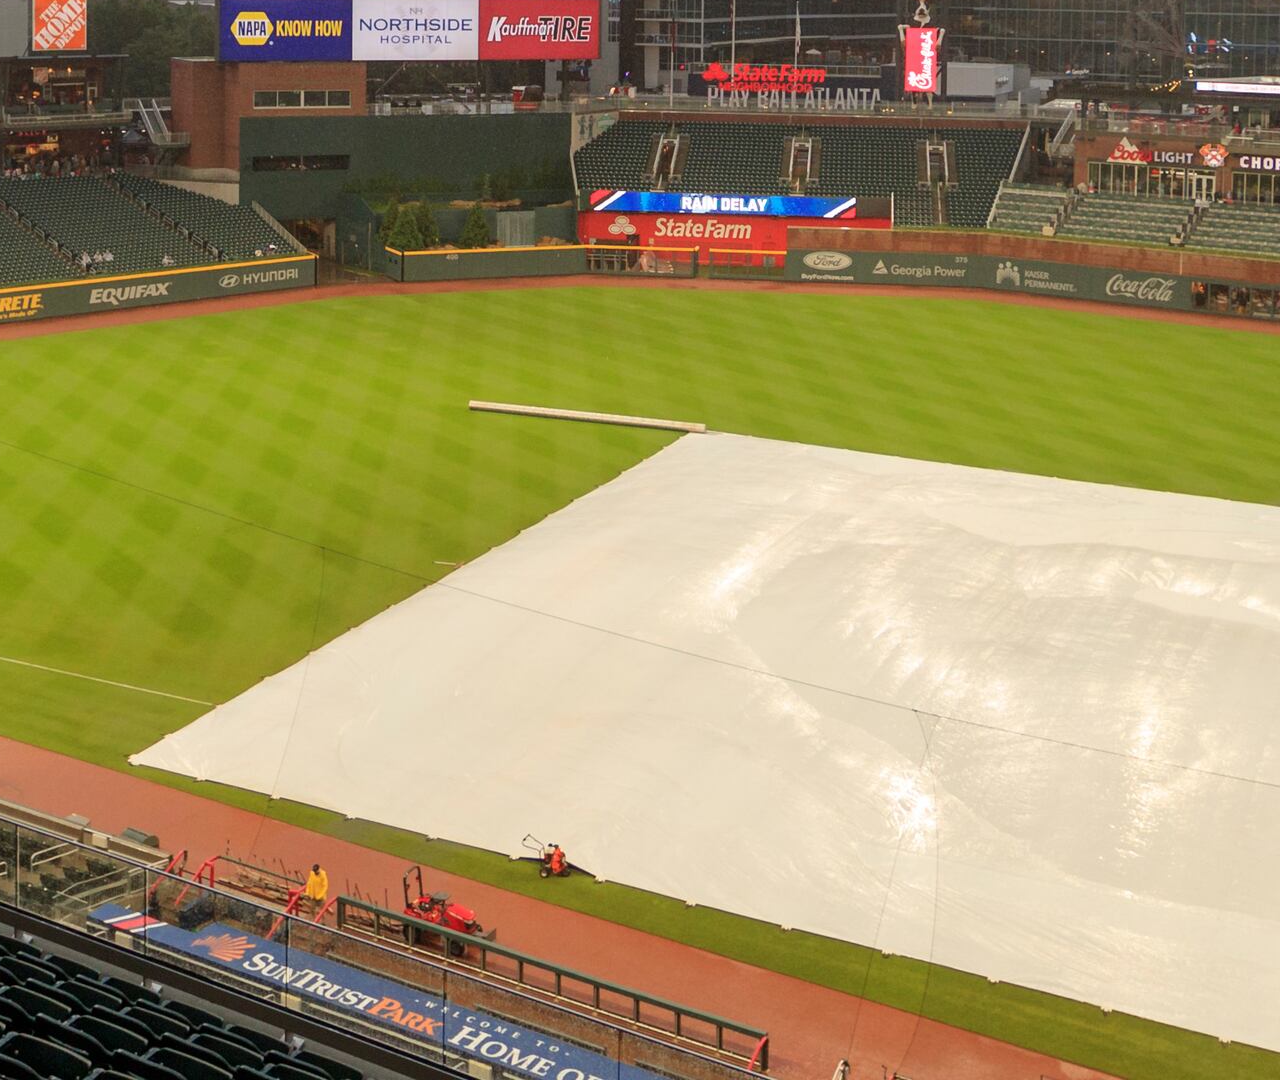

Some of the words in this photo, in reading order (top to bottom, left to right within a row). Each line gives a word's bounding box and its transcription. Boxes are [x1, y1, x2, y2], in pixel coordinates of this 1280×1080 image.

[39, 0, 62, 22] THE
[54, 15, 86, 50] DEPOT
[238, 21, 267, 37] NAPA
[276, 20, 312, 38] KNOW
[314, 20, 343, 37] HOW
[359, 18, 473, 32] NORTHSIDE
[539, 16, 592, 42] TIRE
[380, 34, 452, 45] HOSPITAL
[707, 85, 750, 108] PLAY
[757, 86, 800, 110] BALL
[804, 87, 882, 111] ATLANTA
[1153, 150, 1193, 164] LIGHT
[681, 195, 718, 211] RAIN
[720, 197, 768, 212] DELAY
[814, 254, 842, 269] Ford
[242, 267, 299, 286] HYUNDAI
[890, 264, 932, 278] Georgia
[934, 265, 967, 278] Power
[1024, 270, 1050, 280] KAISER
[89, 281, 171, 306] EQUIFAX
[1105, 273, 1178, 303] Coca-Cola
[447, 1024, 557, 1076] HOME
